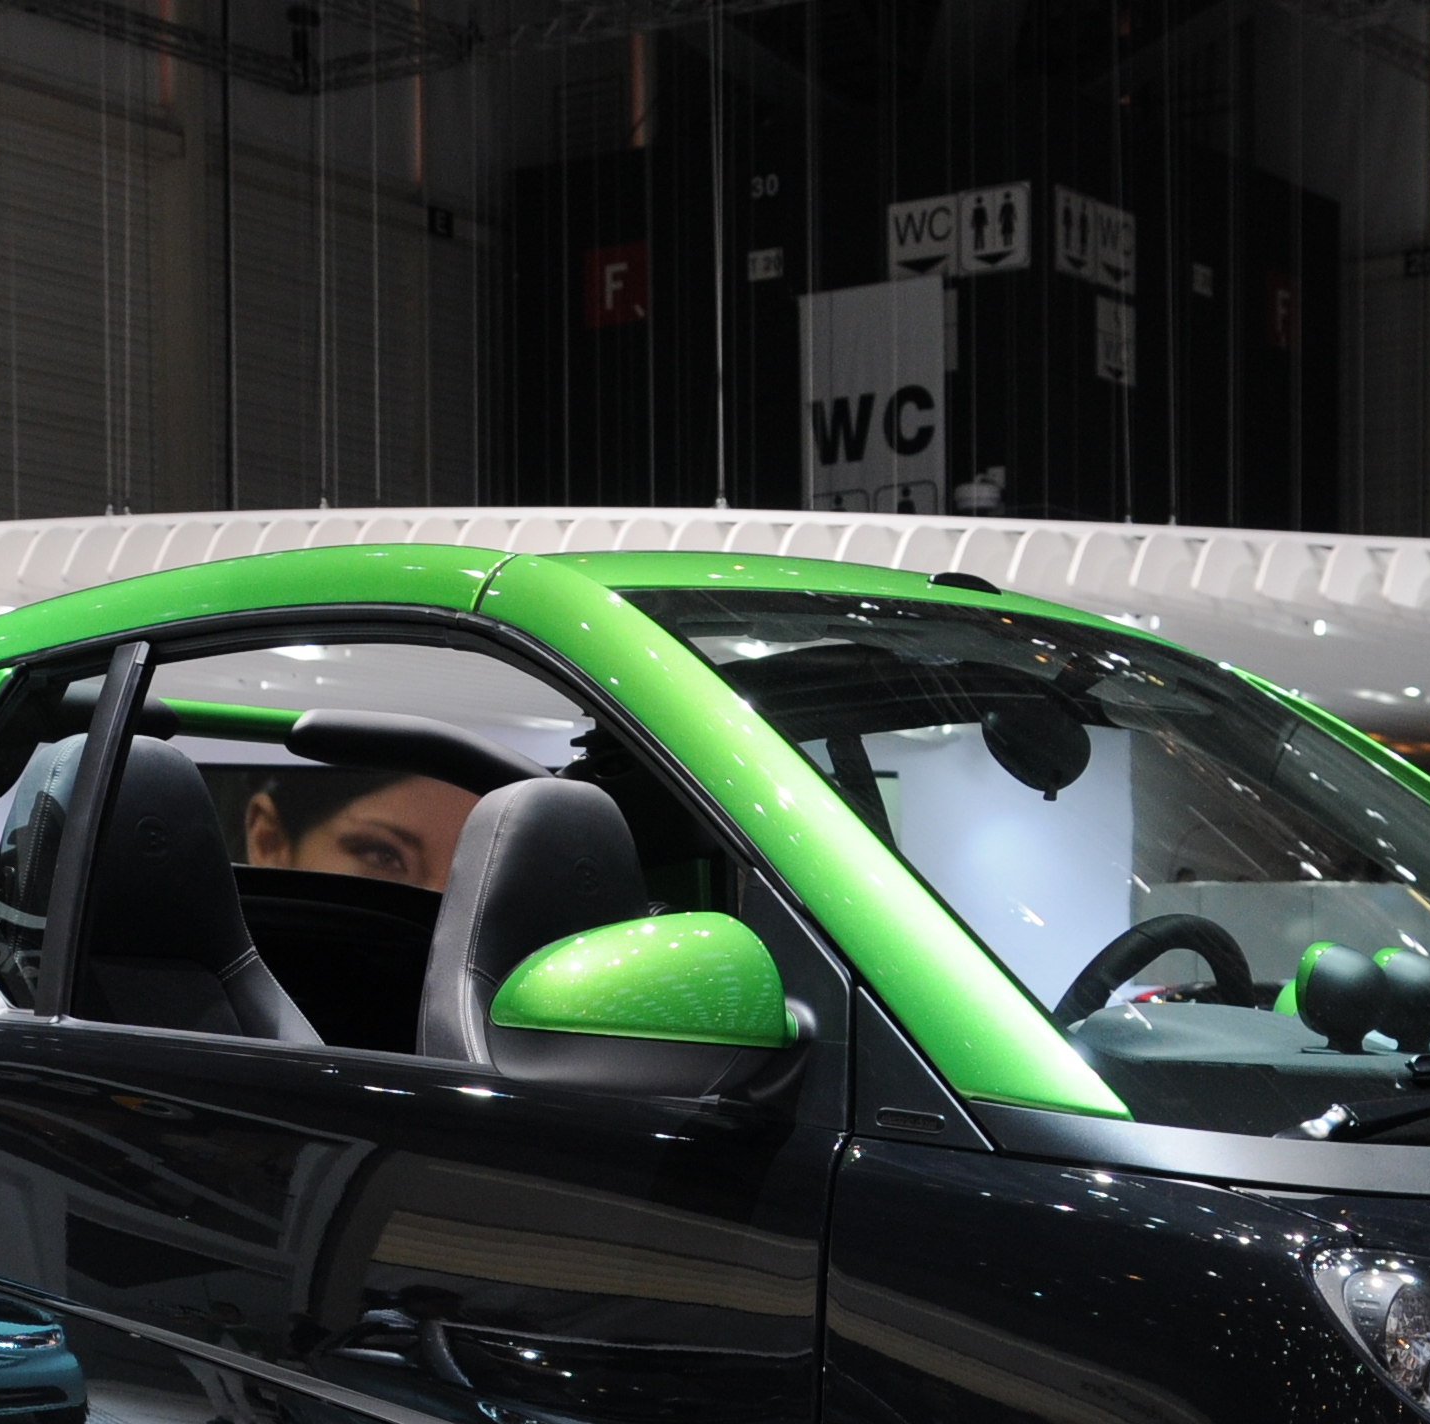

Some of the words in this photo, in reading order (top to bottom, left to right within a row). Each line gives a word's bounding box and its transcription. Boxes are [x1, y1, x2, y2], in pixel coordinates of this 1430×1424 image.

[750, 173, 780, 199] 30
[894, 205, 952, 247] WC
[604, 262, 628, 311] F
[812, 384, 935, 465] WC
